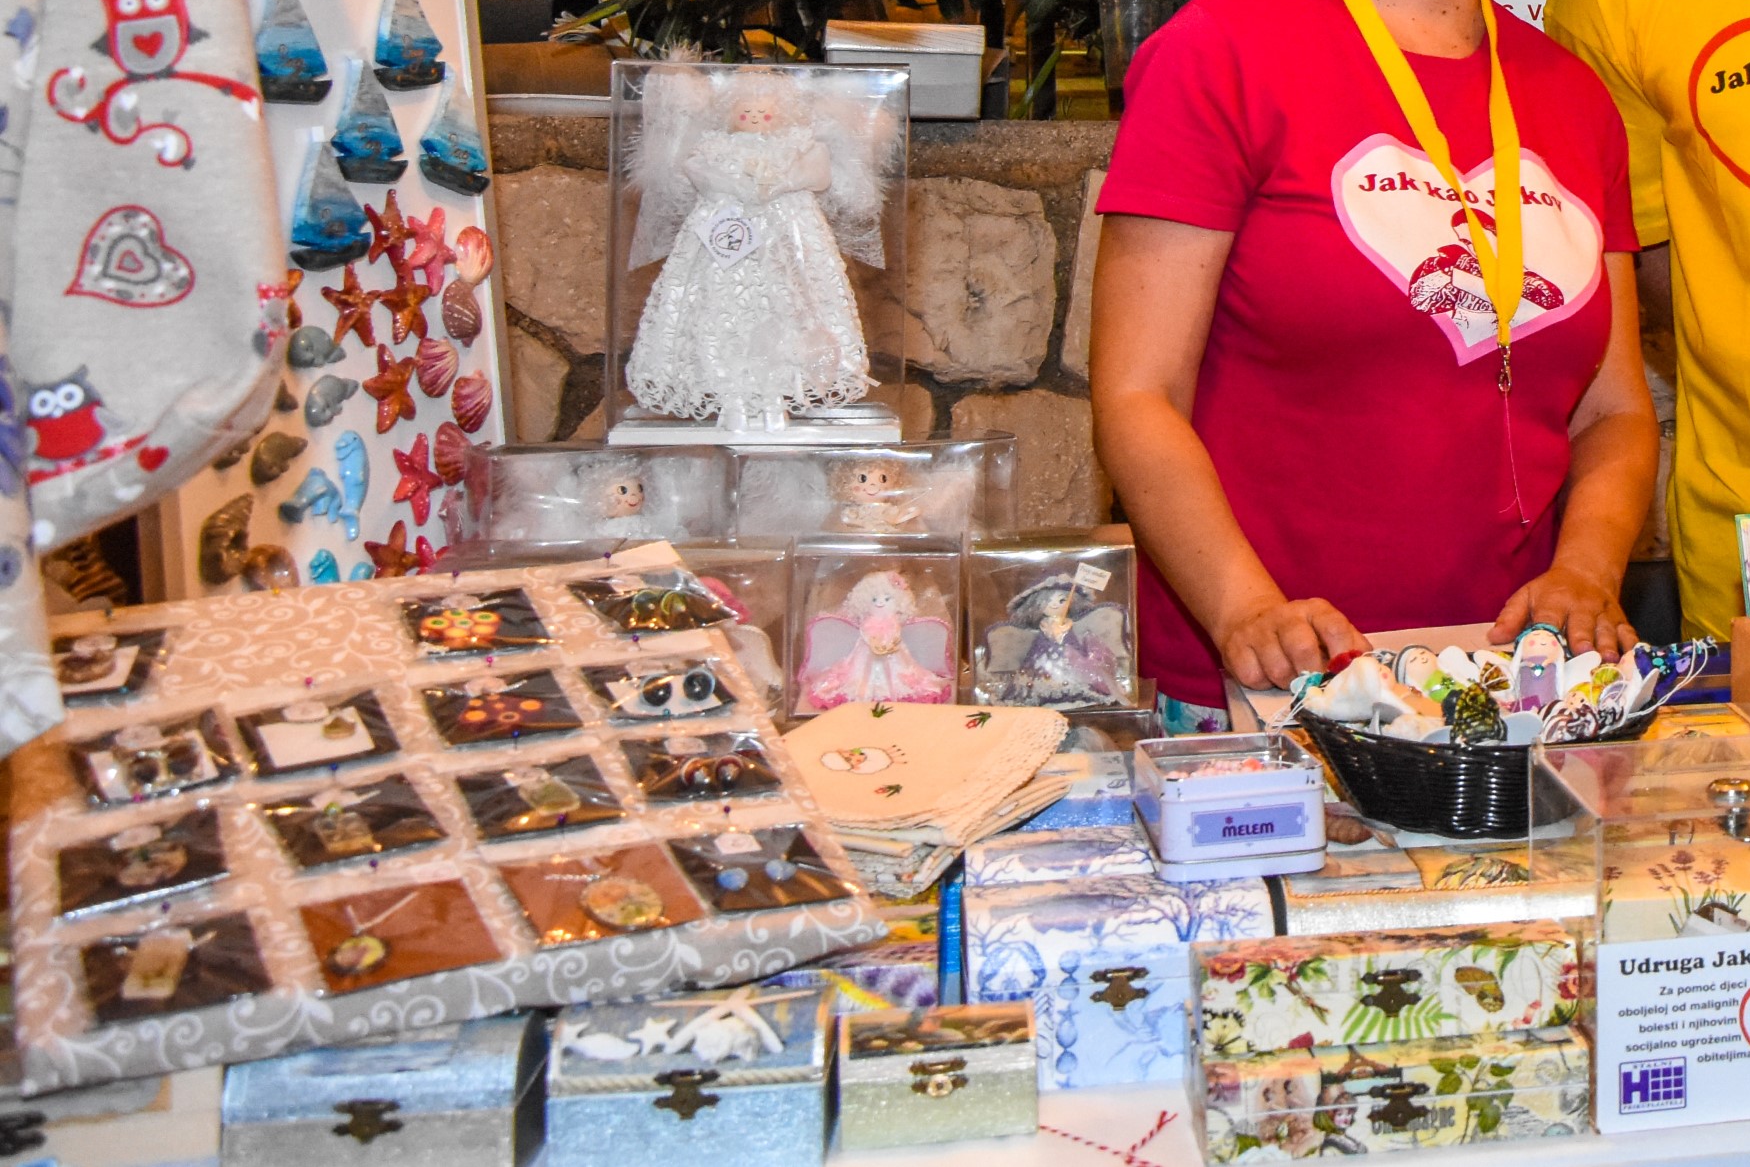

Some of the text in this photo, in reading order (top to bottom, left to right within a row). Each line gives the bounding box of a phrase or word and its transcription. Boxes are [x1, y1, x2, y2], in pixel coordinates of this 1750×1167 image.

[1358, 171, 1562, 212] Jak kao Jkov
[1222, 821, 1274, 837] MELEM
[1619, 953, 1705, 976] Udruga
[1659, 978, 1748, 997] Za pomoć djeci
[1618, 997, 1740, 1018] oboljeloj od malignih
[1639, 1016, 1738, 1034] bolesti i njihovim
[1625, 1032, 1742, 1053] socijalno ugroženim
